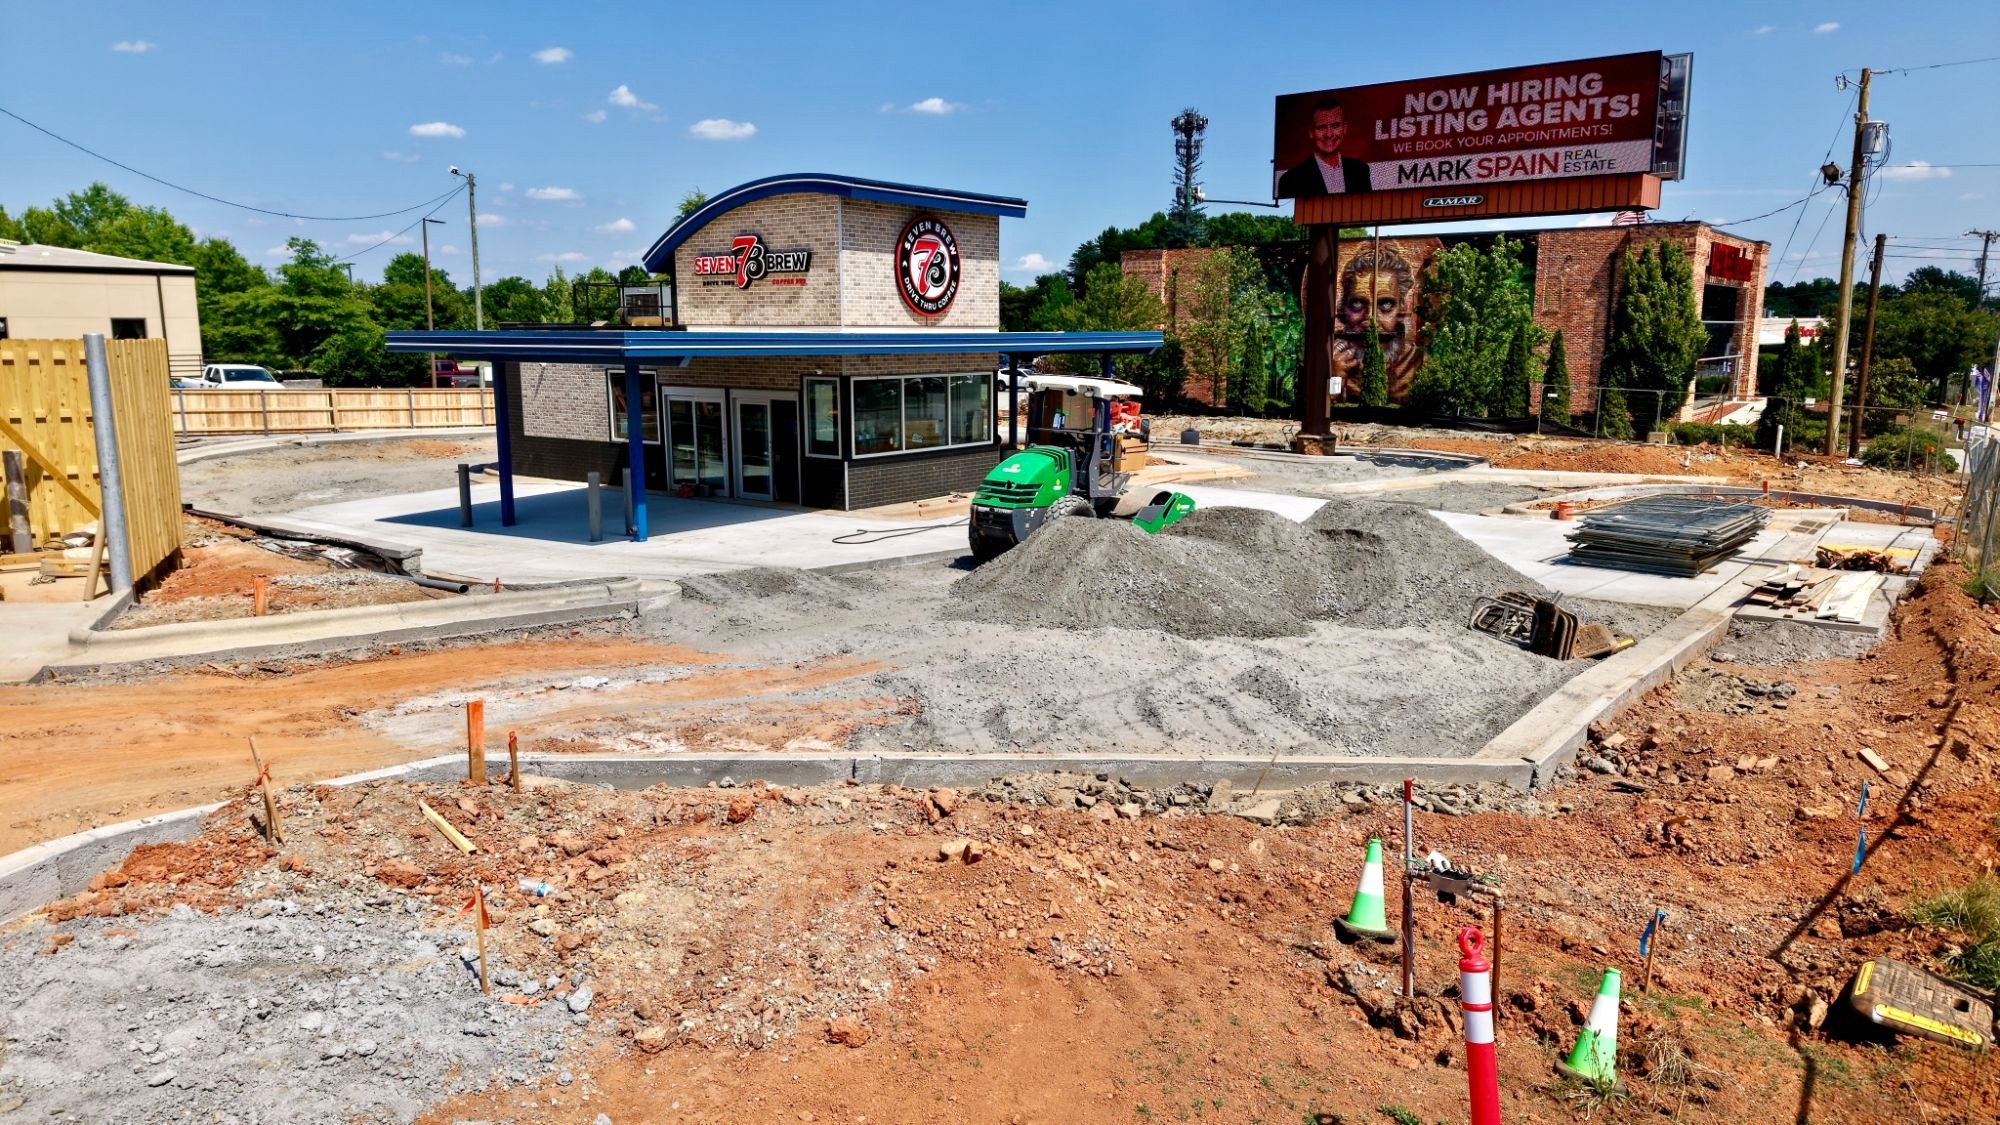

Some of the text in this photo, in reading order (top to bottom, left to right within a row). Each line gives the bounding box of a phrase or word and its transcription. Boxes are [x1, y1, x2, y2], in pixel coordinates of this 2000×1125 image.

[1404, 72, 1604, 115] NOW HIRING
[1375, 93, 1641, 141] LISTING AGENTS!
[1392, 124, 1613, 154] WE BOOK YOUR APPOINTMENTS!
[1397, 151, 1560, 185] MARK SPAIN
[1563, 159, 1617, 173] ESTATE
[1564, 149, 1602, 162] REAL
[1428, 196, 1478, 206] LAMAR
[904, 220, 957, 255] SEVEN BREW
[694, 256, 736, 274] SEVEN
[766, 252, 807, 272] BREW
[903, 277, 957, 311] DRIVE THRU COFFEE
